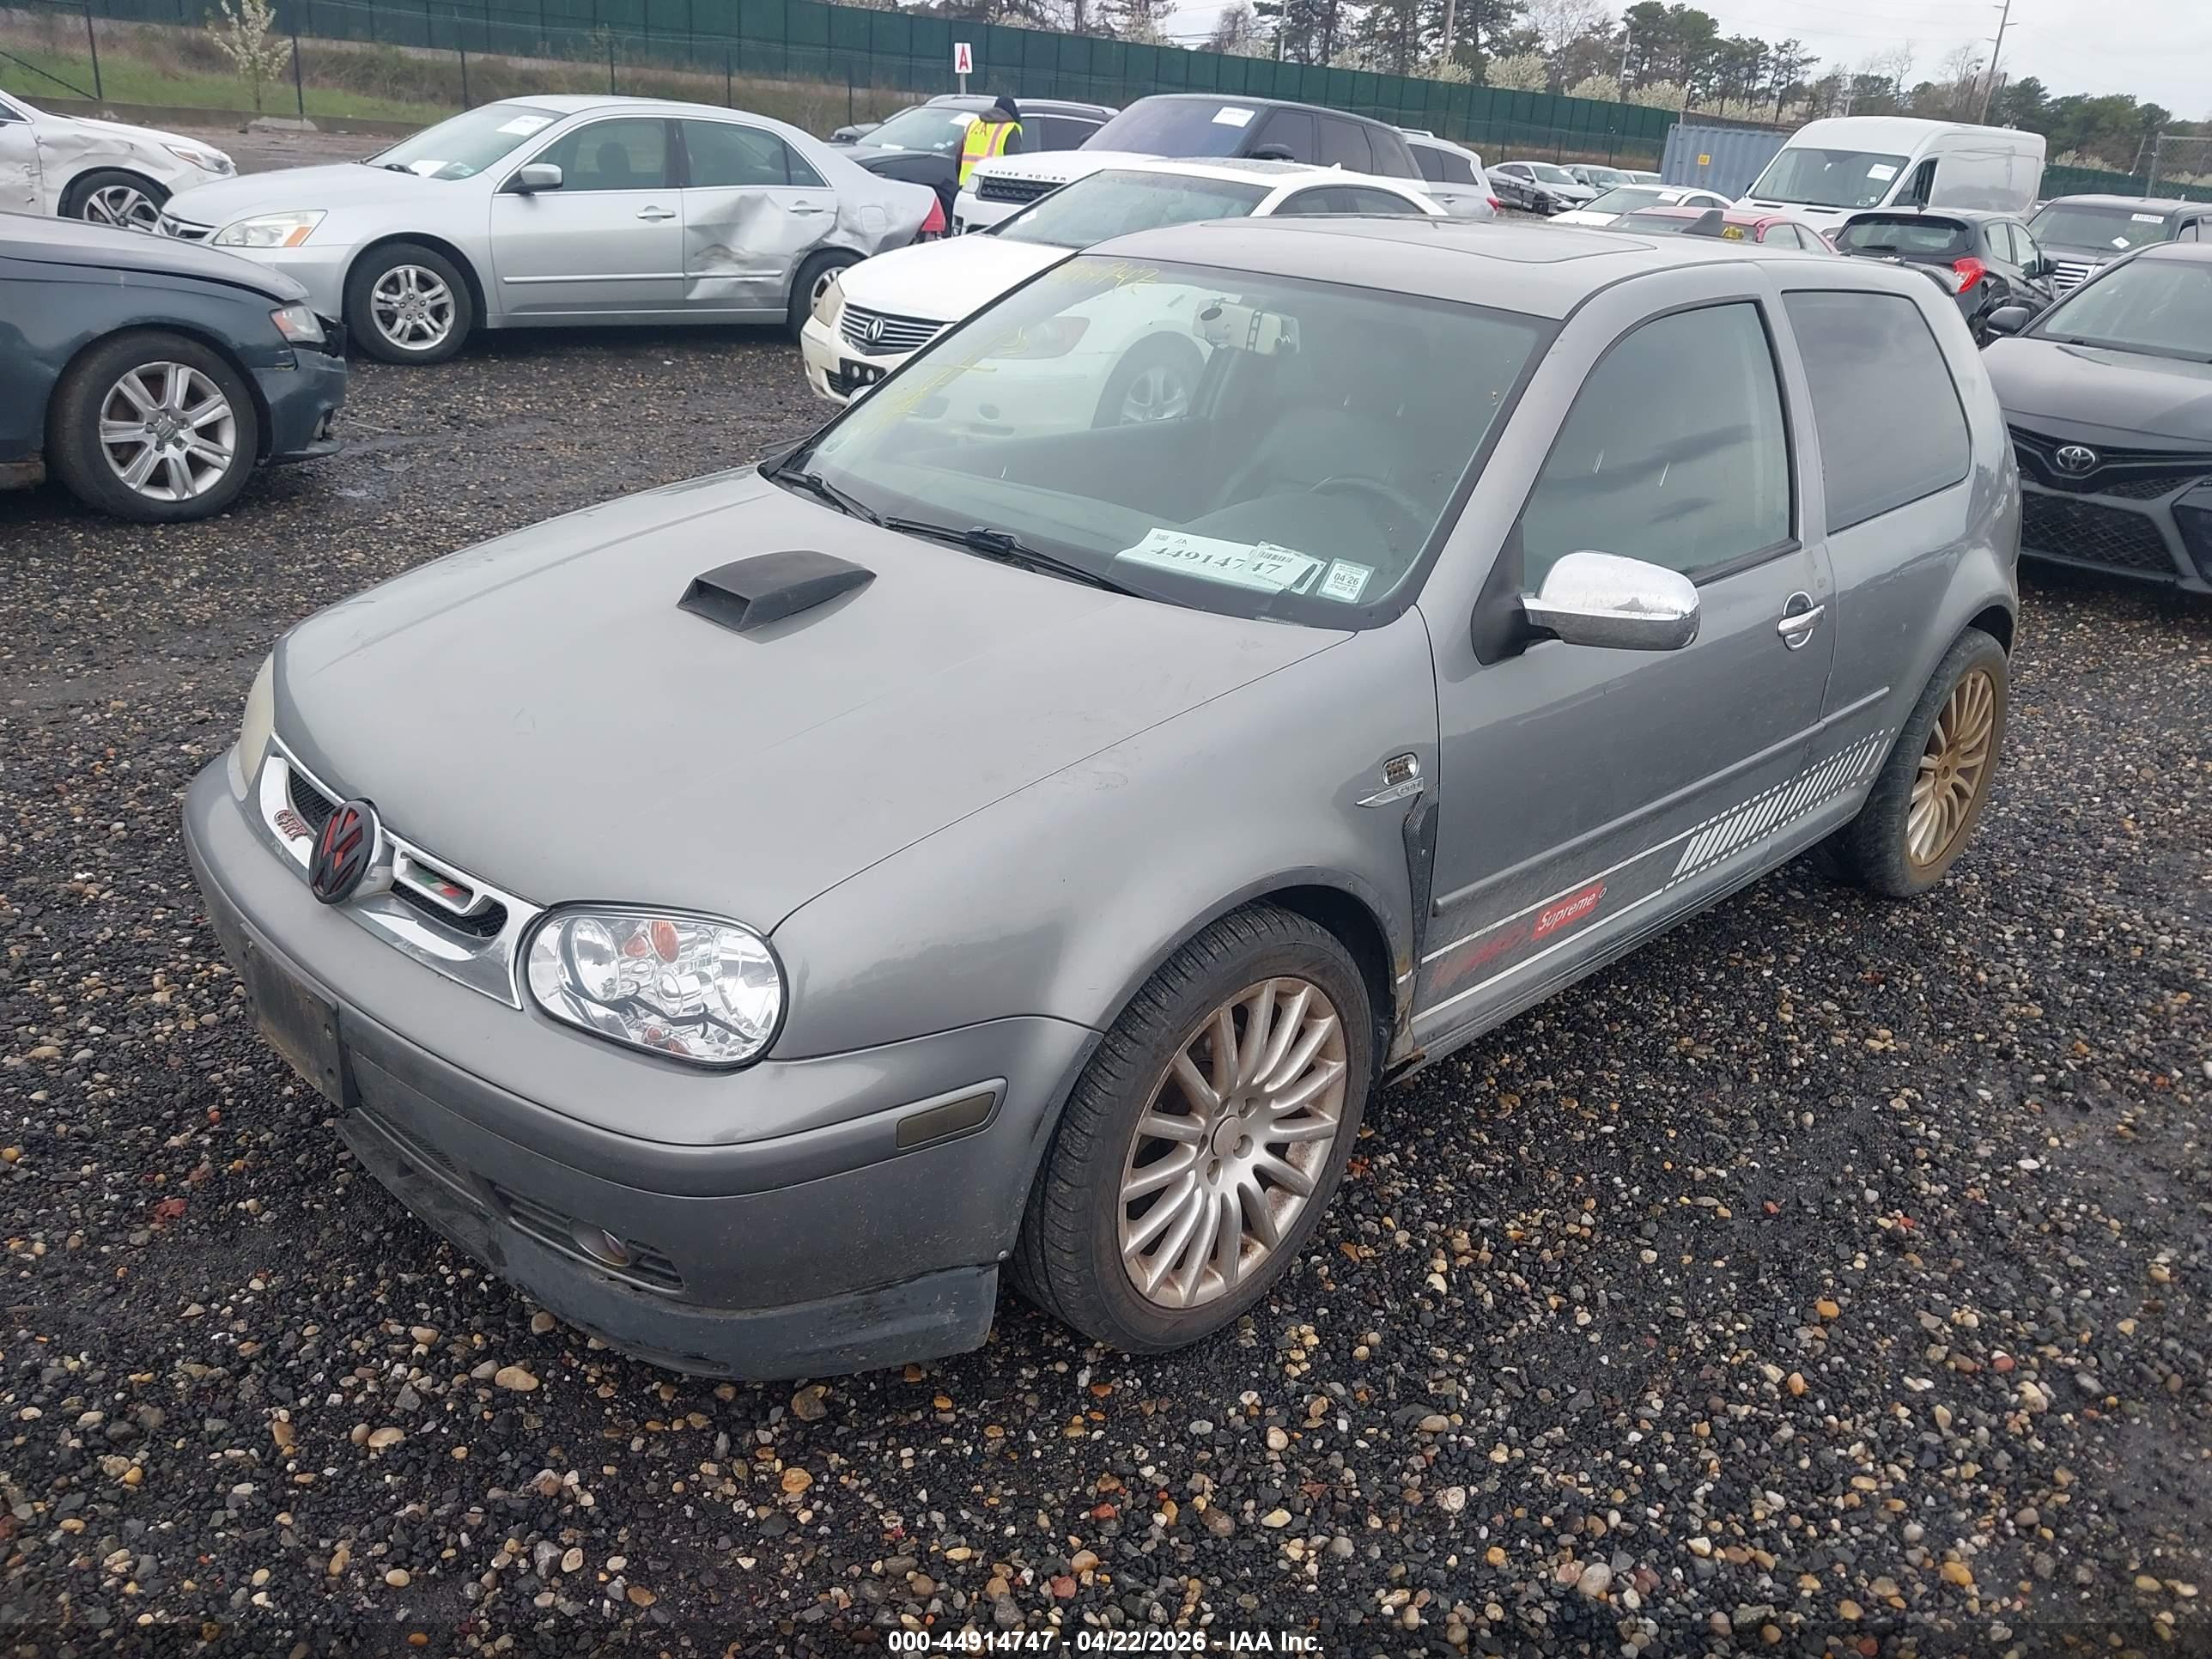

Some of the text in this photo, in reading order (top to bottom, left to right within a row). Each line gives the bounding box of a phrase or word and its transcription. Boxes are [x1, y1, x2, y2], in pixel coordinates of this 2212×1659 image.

[958, 45, 969, 70] A
[274, 810, 307, 842] GTI
[1538, 891, 1596, 932] Supreme
